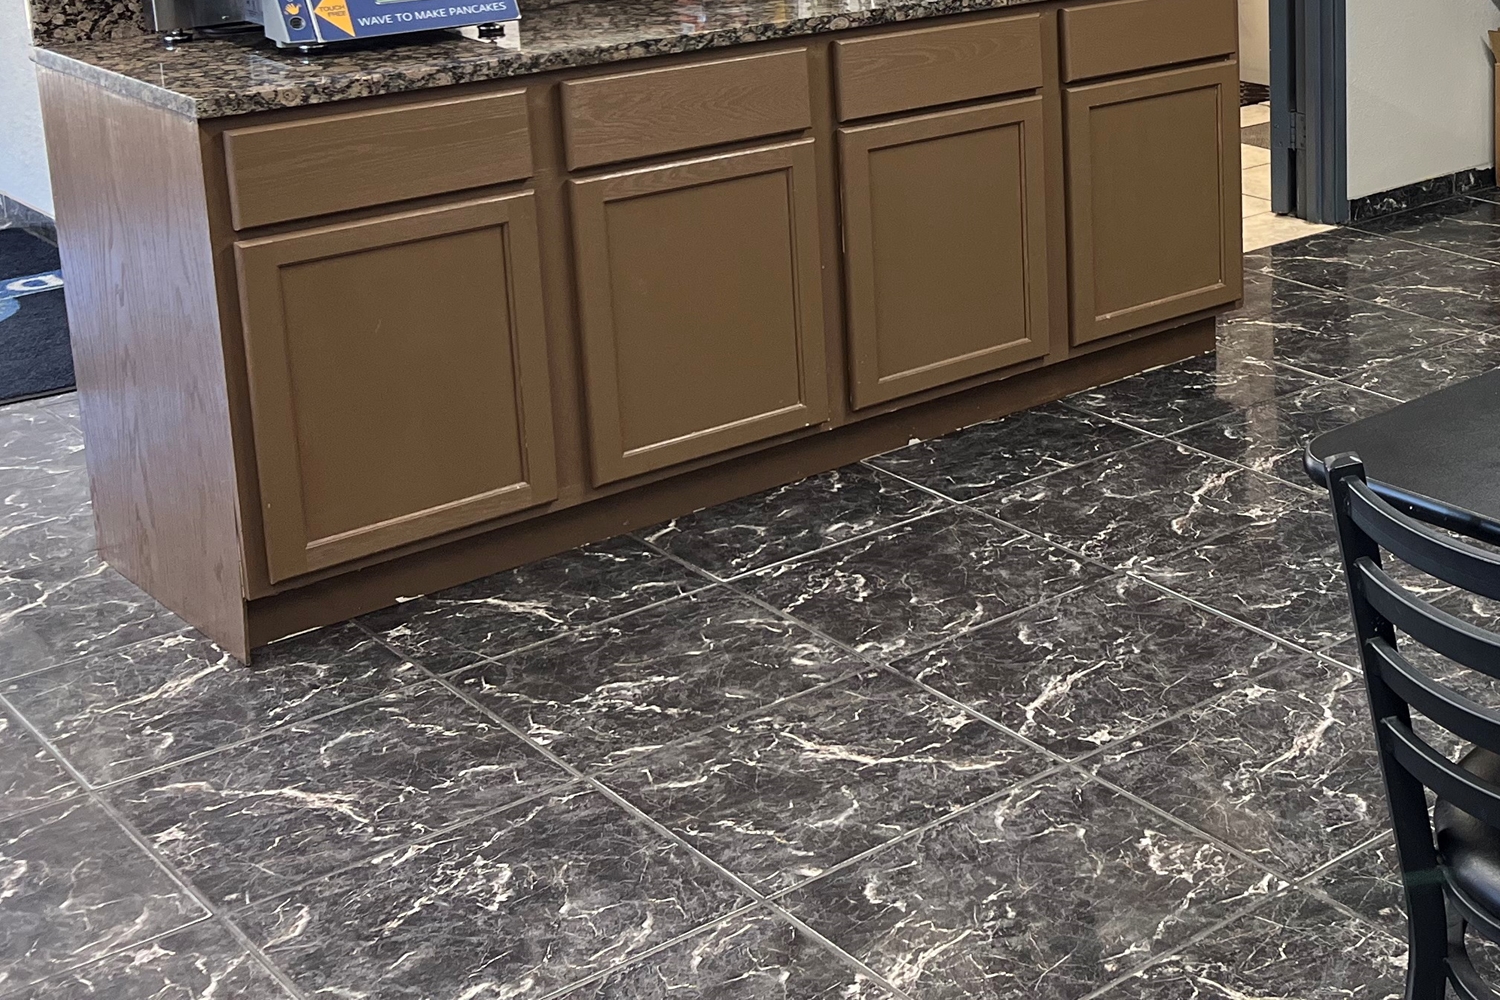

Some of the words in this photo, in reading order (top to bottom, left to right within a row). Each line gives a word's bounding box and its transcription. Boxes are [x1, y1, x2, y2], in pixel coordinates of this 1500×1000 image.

[318, 3, 345, 13] TOUCH
[327, 10, 346, 18] FREE
[357, 14, 394, 27] WAVE
[396, 12, 413, 23] TO
[414, 7, 447, 21] MAKE
[449, 1, 507, 16] PANCAKES
